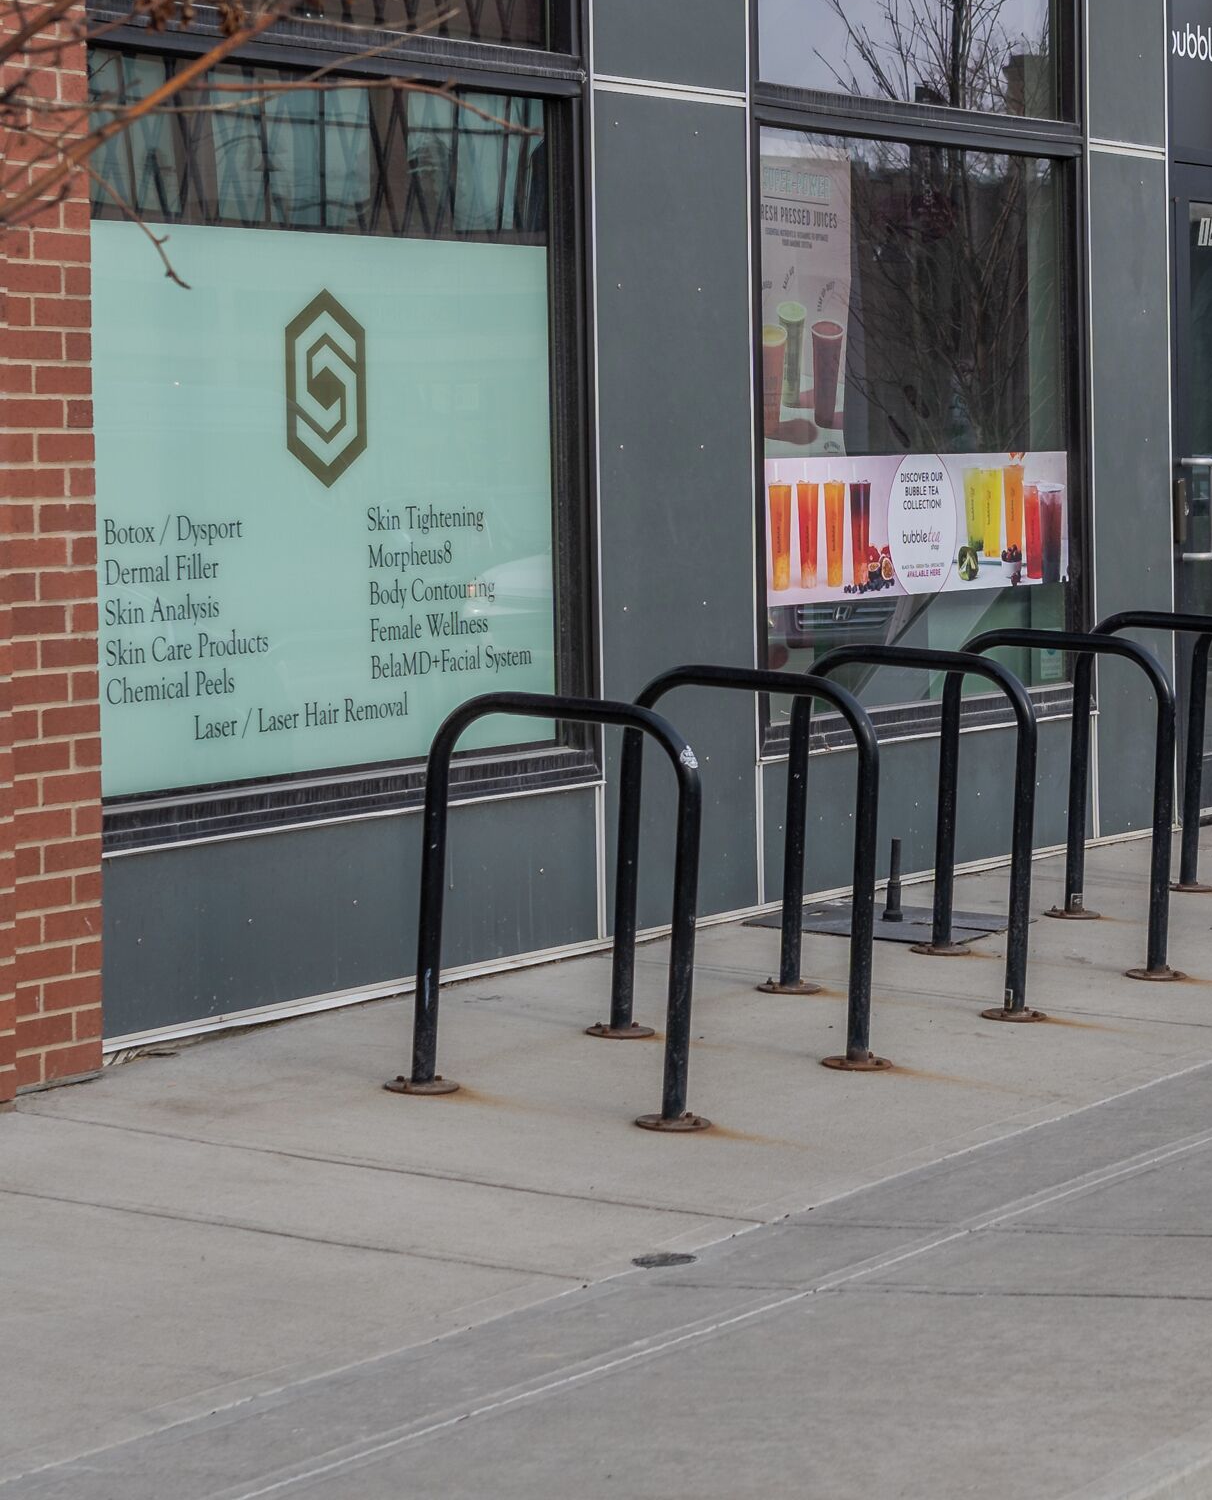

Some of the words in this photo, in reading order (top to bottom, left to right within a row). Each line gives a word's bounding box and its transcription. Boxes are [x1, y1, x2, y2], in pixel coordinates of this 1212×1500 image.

[780, 206, 811, 226] PRESSED
[813, 210, 838, 229] JUICES
[900, 472, 929, 483] DISCOVER
[930, 471, 944, 482] OUR
[905, 485, 927, 496] BUBBLE
[928, 485, 939, 496] TEA
[103, 518, 155, 546] Botox
[177, 515, 243, 546] Dysport
[366, 505, 401, 532] Skin
[405, 504, 484, 533] Tightening
[902, 529, 928, 544] bubble
[927, 525, 942, 543] tea
[104, 555, 171, 586] Dermal
[175, 553, 219, 582] Filler
[368, 541, 453, 573] Morpheus8
[369, 579, 407, 608] Body
[411, 577, 496, 603] Contouring
[104, 595, 146, 627] Skin
[151, 595, 220, 625] Analysis
[370, 616, 423, 643] Female
[426, 612, 489, 638] Wellness
[105, 635, 146, 667] Skin
[151, 636, 193, 664] Care
[198, 629, 269, 660] Products
[371, 648, 481, 680] BelaMD+Facial
[485, 645, 532, 672] System
[106, 673, 190, 706] Chemical
[195, 669, 235, 699] Peels
[194, 712, 238, 741] Laser
[258, 705, 300, 734] Laser
[304, 700, 340, 729] Hair
[344, 691, 409, 723] Removal
